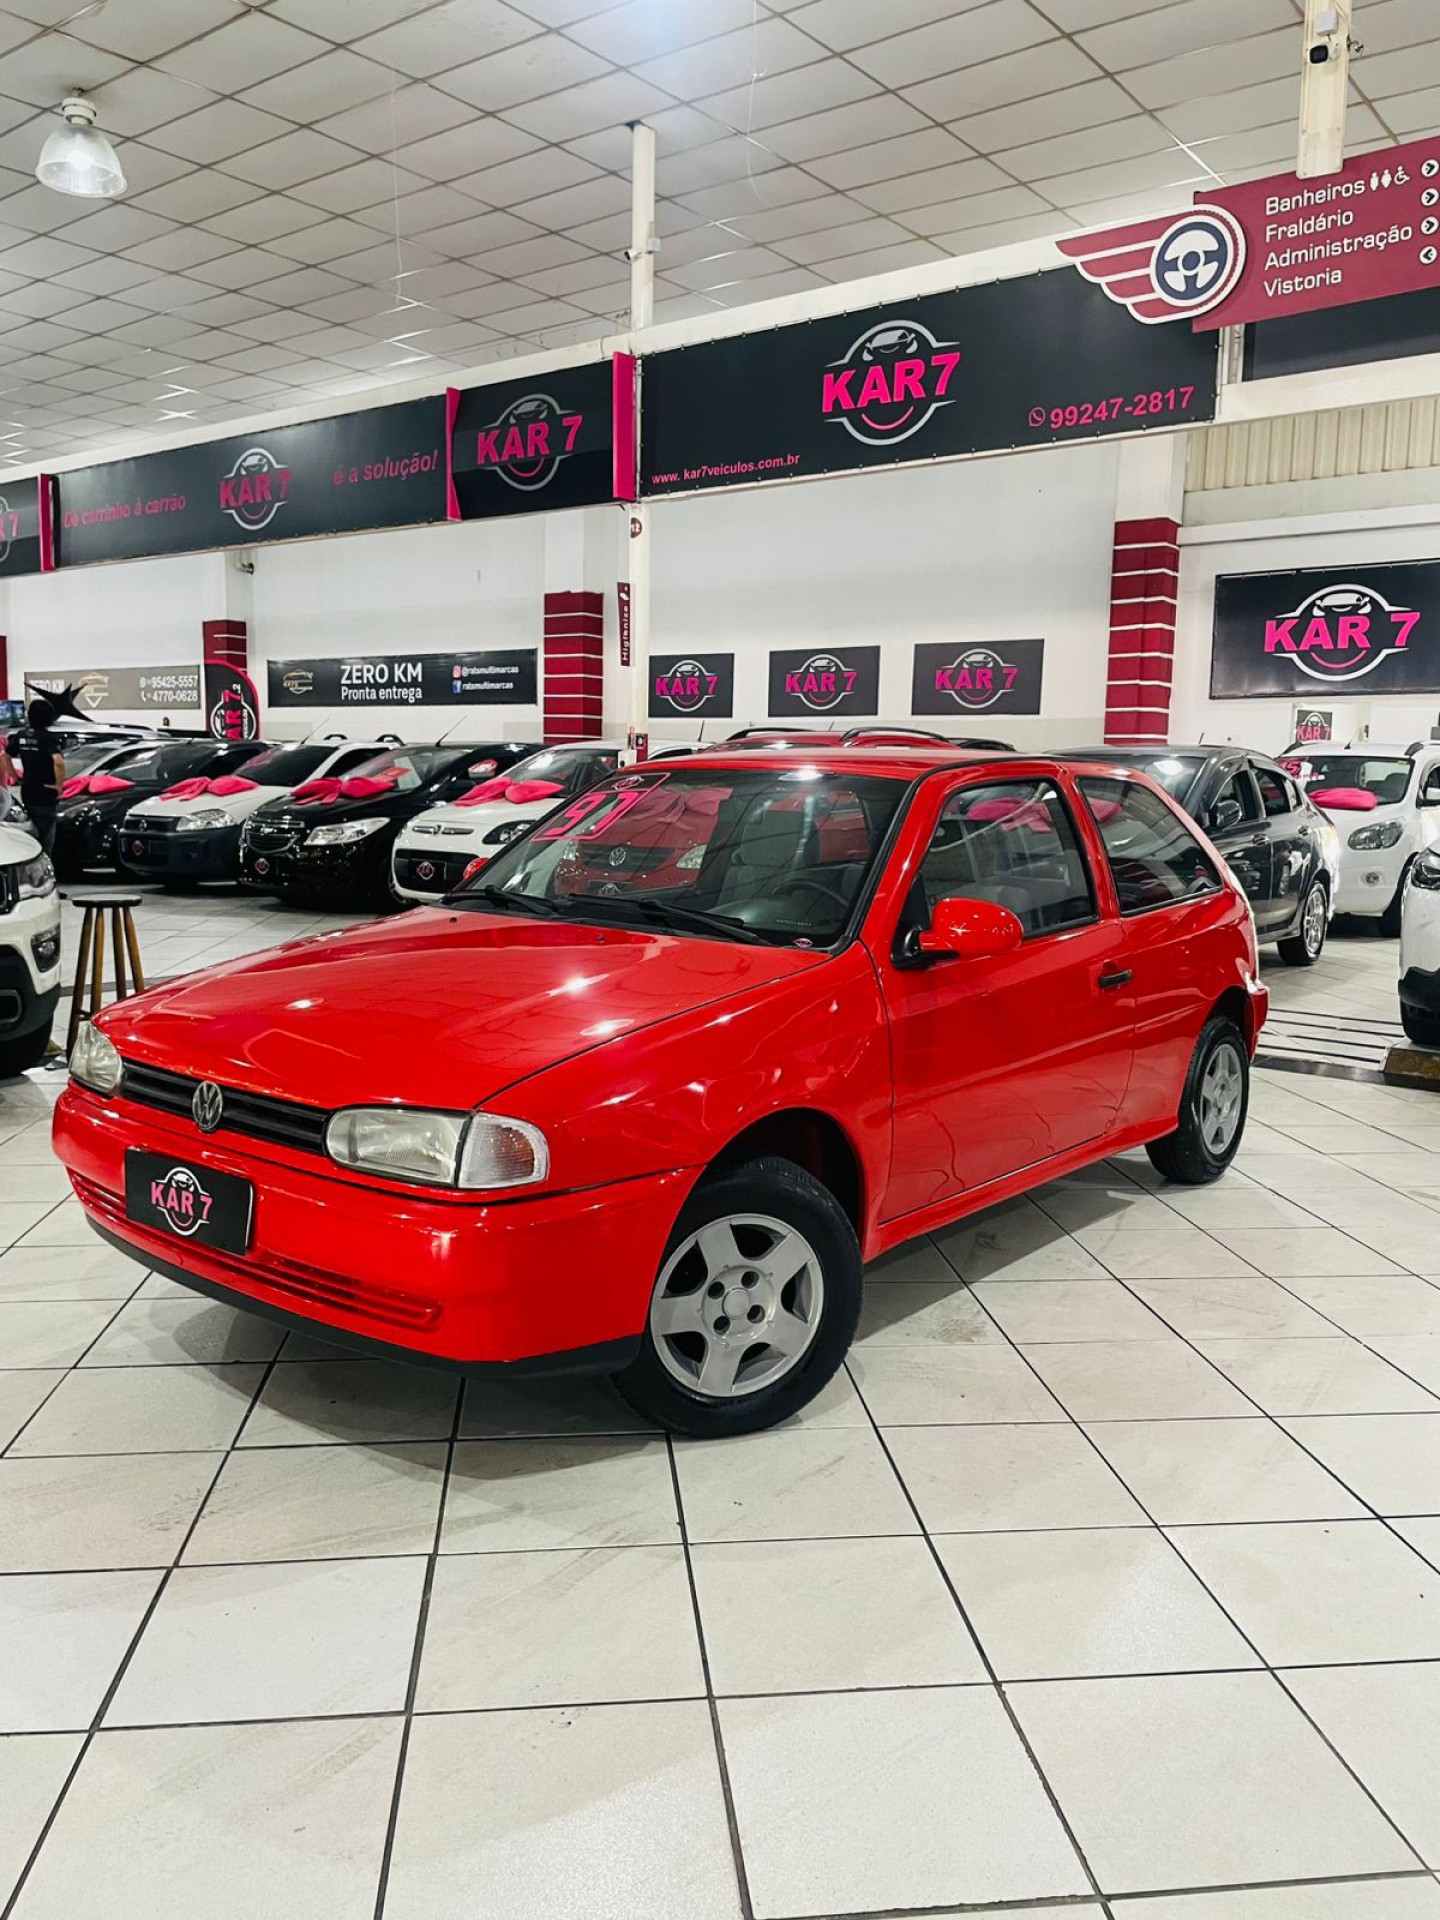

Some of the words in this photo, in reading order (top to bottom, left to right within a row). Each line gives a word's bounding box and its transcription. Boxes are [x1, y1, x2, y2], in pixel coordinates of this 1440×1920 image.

[1265, 178, 1366, 216] Banheiros
[1265, 209, 1354, 243] Fraldário
[1264, 224, 1414, 271] Administração
[1264, 269, 1343, 298] Vistoria
[821, 357, 925, 414] KAR
[930, 352, 961, 395] 7
[1050, 386, 1195, 429] 99247-2817
[477, 422, 550, 465] KAR
[562, 414, 584, 452] 7
[348, 466, 359, 483] a
[363, 449, 439, 481] solução!
[651, 472, 681, 485] www.
[683, 453, 802, 481] kar7veiculos.com.br
[145, 493, 187, 515] carrão
[219, 473, 272, 510] KAR
[277, 469, 293, 500] 7
[1264, 615, 1371, 652] KAR
[1390, 611, 1421, 647] 7
[341, 663, 388, 685] ZERO
[395, 662, 422, 684] KM
[655, 677, 700, 696] KAR
[706, 676, 718, 695] 7
[785, 672, 836, 693] KAR
[843, 671, 858, 692] 7
[935, 668, 994, 691] KAR
[1002, 667, 1018, 689] 7
[341, 686, 376, 700] Pronta
[379, 685, 422, 703] entrega
[1296, 725, 1320, 741] KAR
[543, 791, 639, 836] 97
[151, 1181, 194, 1216] KAR
[200, 1196, 213, 1220] 7
